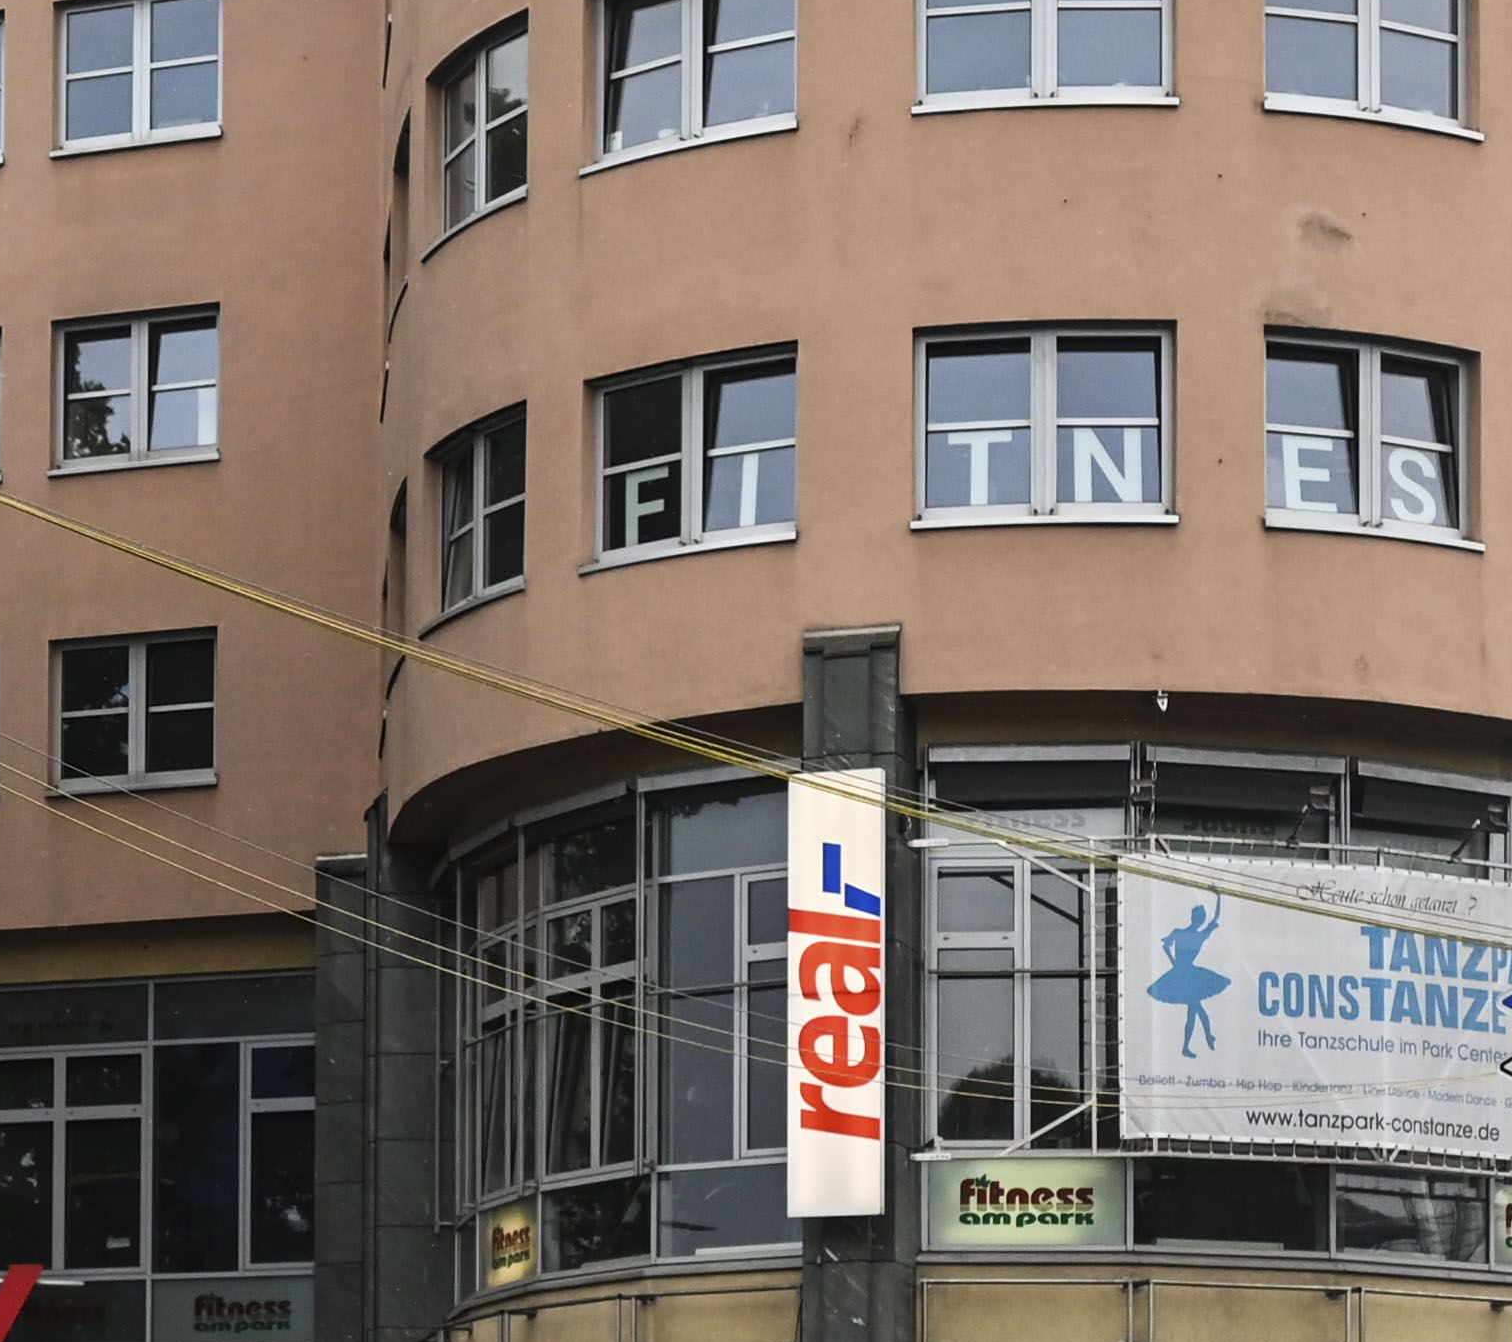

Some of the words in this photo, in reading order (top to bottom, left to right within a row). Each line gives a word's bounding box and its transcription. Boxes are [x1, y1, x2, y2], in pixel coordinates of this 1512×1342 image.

[1258, 971, 1506, 1034] CONSTANZE
[1258, 1029, 1291, 1047] Ihre
[1298, 1031, 1394, 1054] Tanzschule
[1399, 1037, 1417, 1054] im
[1422, 1040, 1453, 1060] Park
[1245, 1108, 1500, 1142] www.tanzpark-constanze.de
[959, 1173, 1094, 1211] fitness
[959, 1212, 1015, 1226] am
[1017, 1212, 1094, 1228] park
[194, 1292, 292, 1320] fitness
